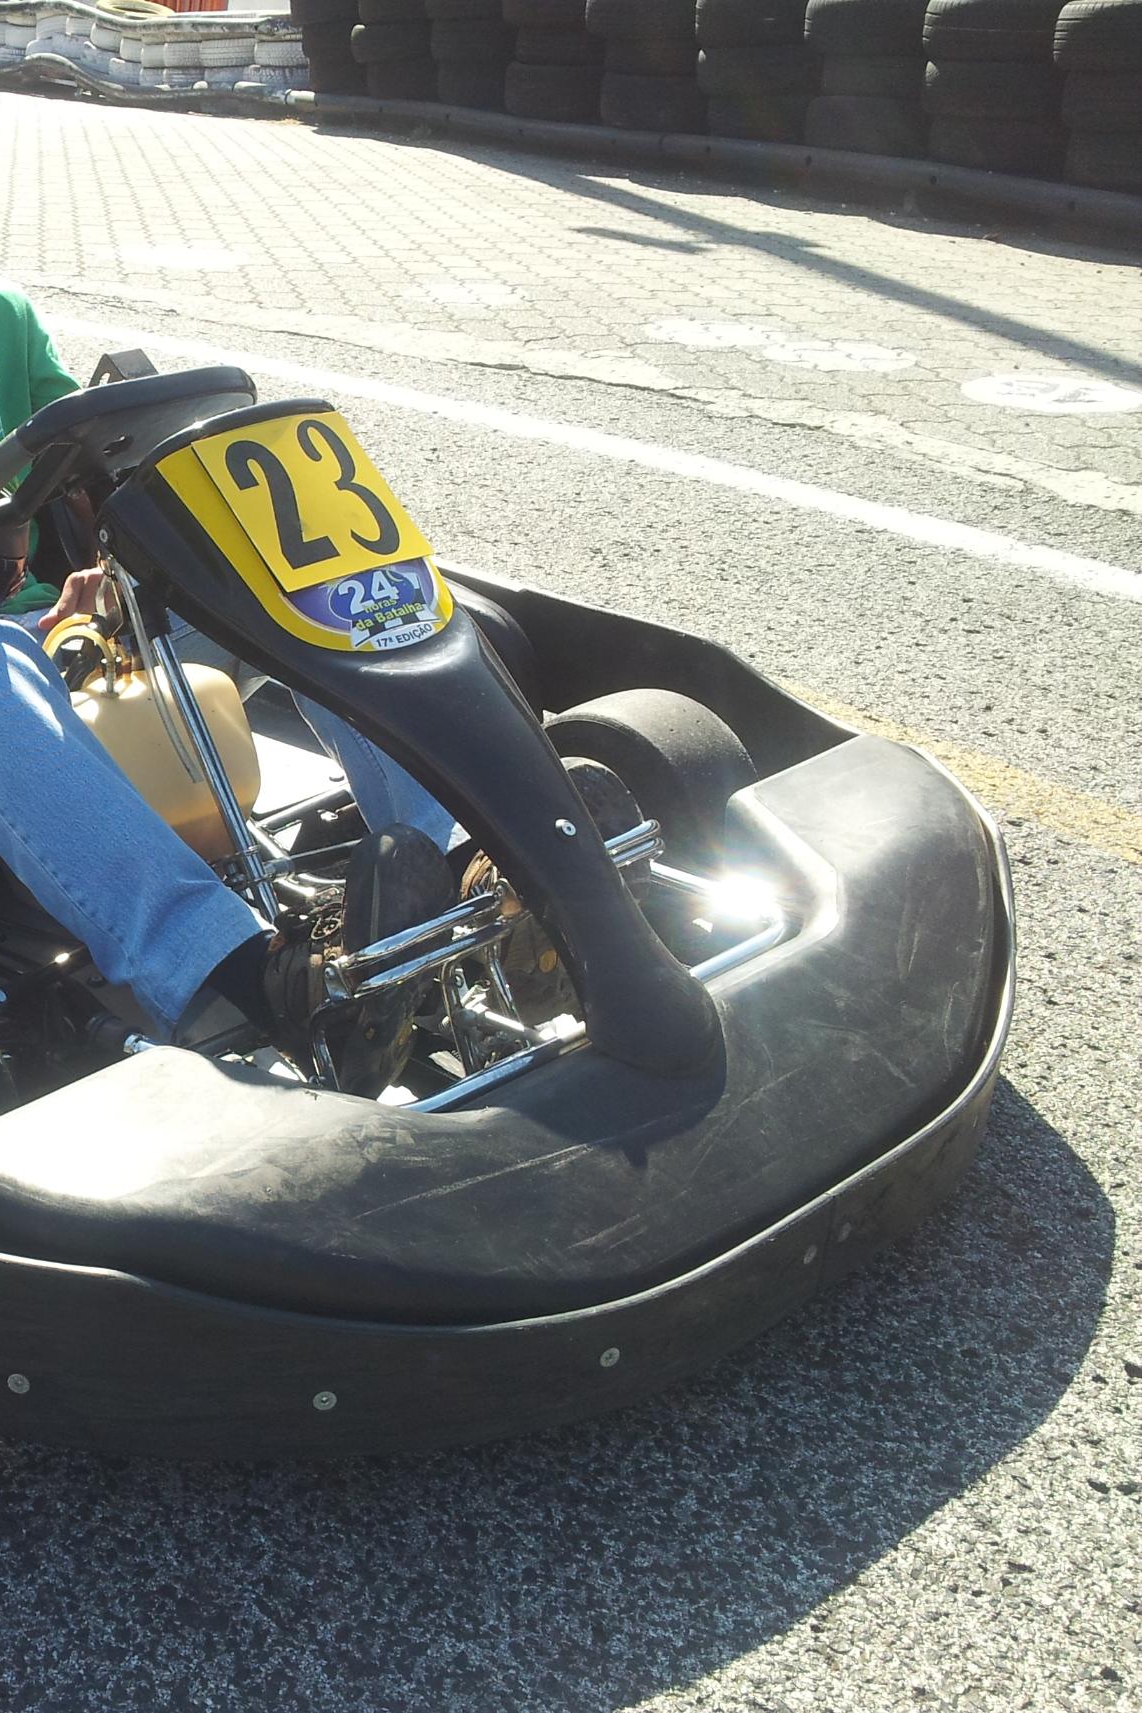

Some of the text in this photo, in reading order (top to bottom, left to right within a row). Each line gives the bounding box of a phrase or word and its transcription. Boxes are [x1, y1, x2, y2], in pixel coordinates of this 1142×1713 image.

[224, 418, 401, 571] 23
[338, 570, 399, 615] 24
[355, 601, 424, 632] da Batalha
[396, 622, 434, 645] EDIÇÃO
